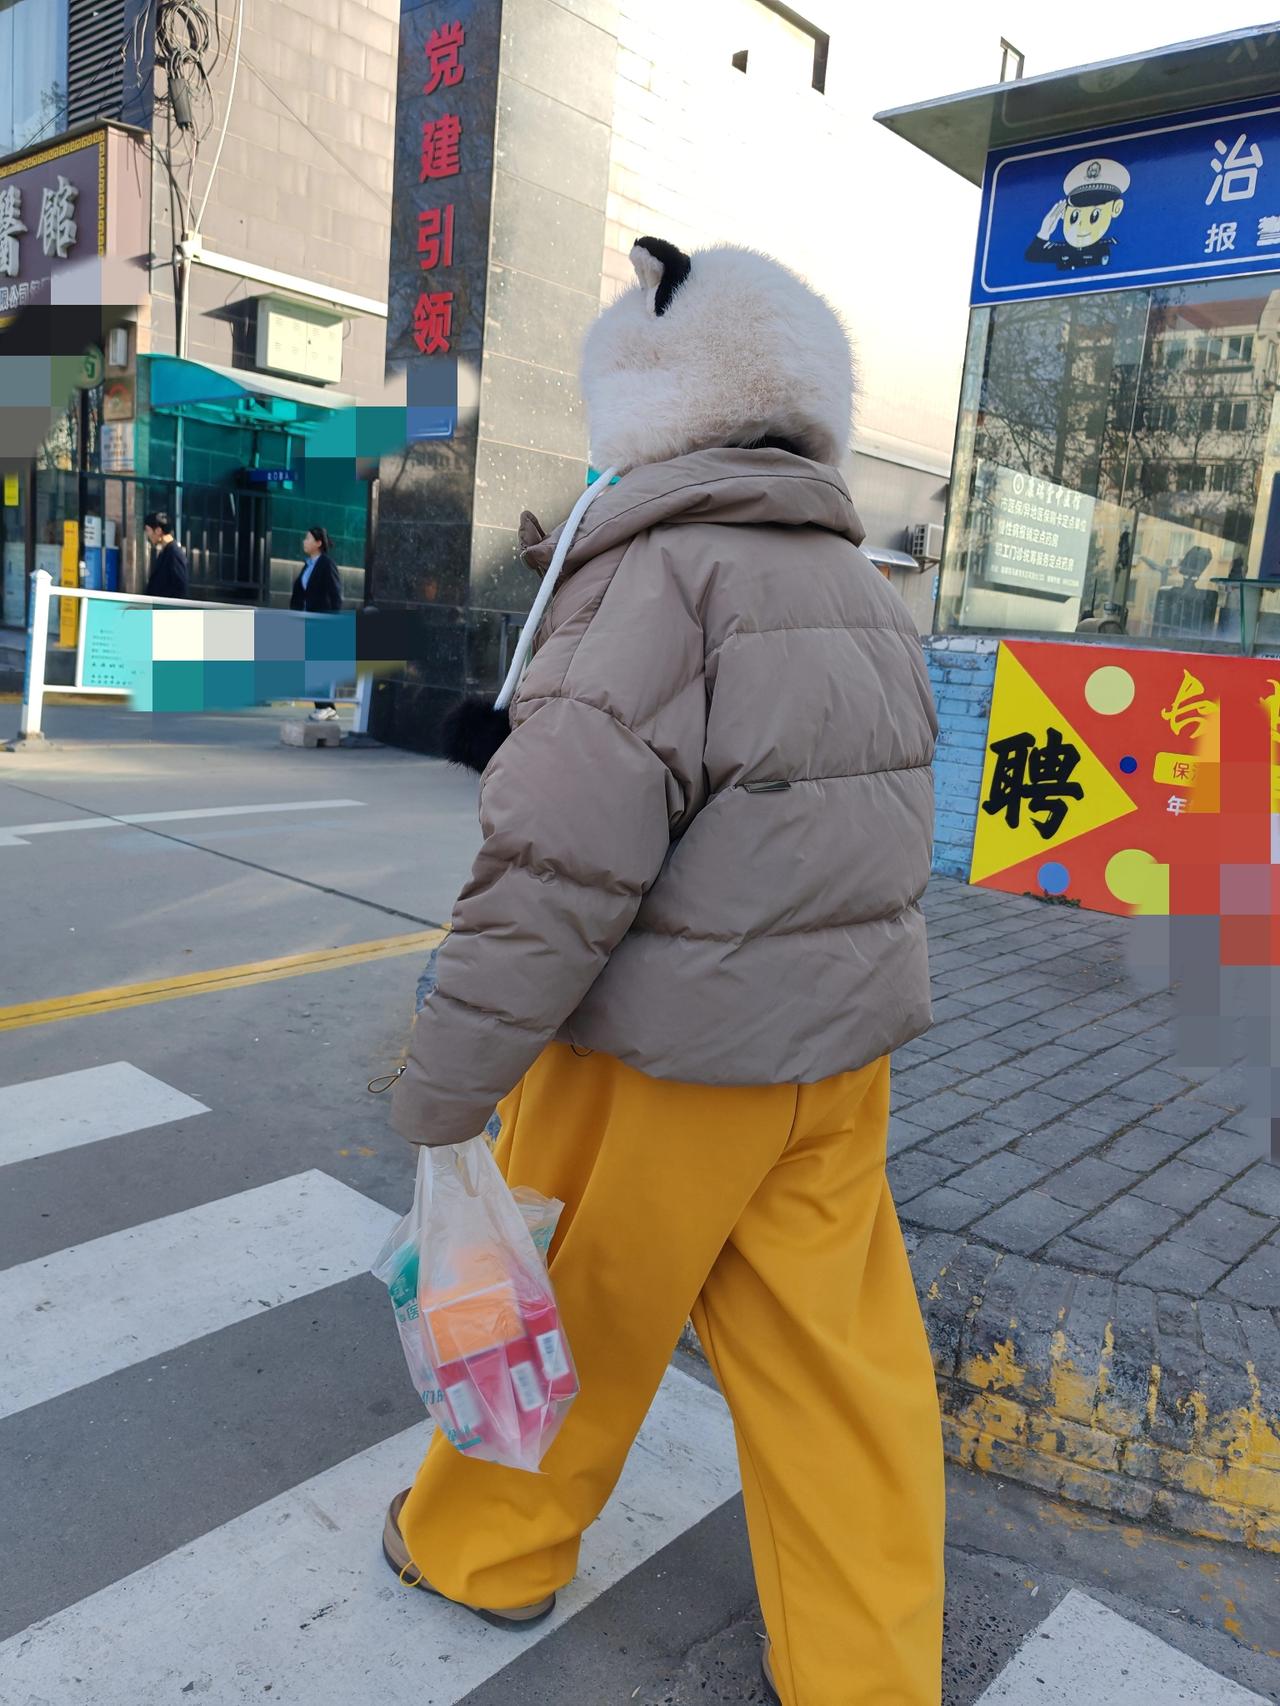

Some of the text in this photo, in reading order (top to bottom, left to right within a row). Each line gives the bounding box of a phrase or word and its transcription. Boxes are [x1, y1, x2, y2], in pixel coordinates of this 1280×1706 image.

[413, 20, 467, 355] 党建引领
[1205, 133, 1263, 206] 治
[982, 726, 1084, 840] 聘
